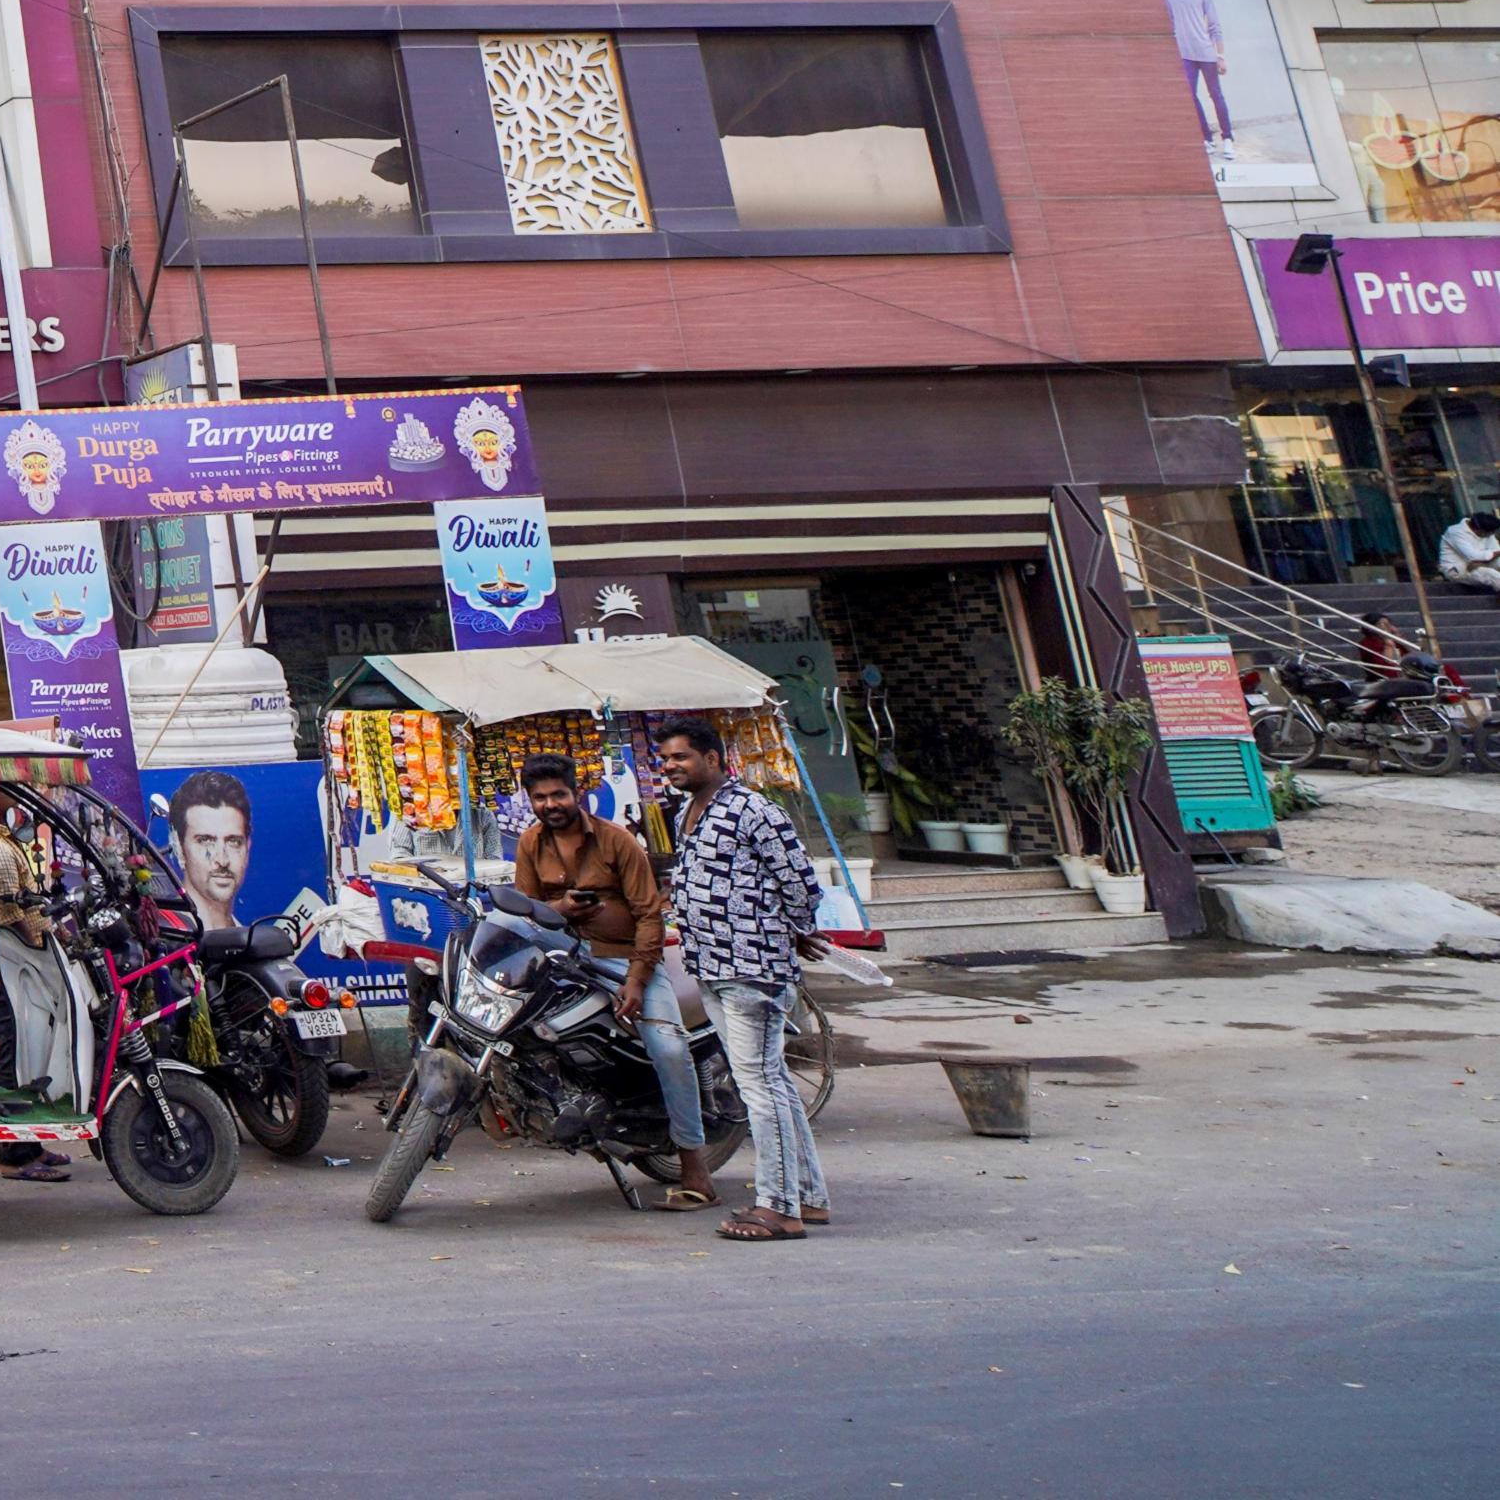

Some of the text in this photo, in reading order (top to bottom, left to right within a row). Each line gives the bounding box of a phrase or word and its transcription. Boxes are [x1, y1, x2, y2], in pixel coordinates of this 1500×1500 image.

[1353, 271, 1467, 316] Price
[93, 421, 141, 436] HAPPY
[186, 418, 334, 451] Parryware
[77, 437, 159, 462] Durga
[245, 448, 340, 466] Pipes & Fittings
[92, 463, 153, 490] Puja
[190, 464, 342, 479] STRONGER LONGER LIFE
[200, 484, 214, 504] के
[215, 483, 256, 505] मौसम
[258, 481, 273, 502] के
[276, 479, 304, 501] लिए
[488, 517, 519, 527] HAPPY
[141, 518, 186, 552] ROMS
[448, 514, 541, 553] Diwali
[44, 544, 75, 554] HAPPY
[3, 543, 98, 582] Diwali
[1143, 659, 1231, 674] Girls Hostel (PG)
[30, 679, 109, 698] Parryware
[82, 723, 122, 740] Meets
[345, 973, 410, 1000] SHAKT
[303, 1011, 338, 1024] UP32N
[308, 1023, 342, 1037] V8564
